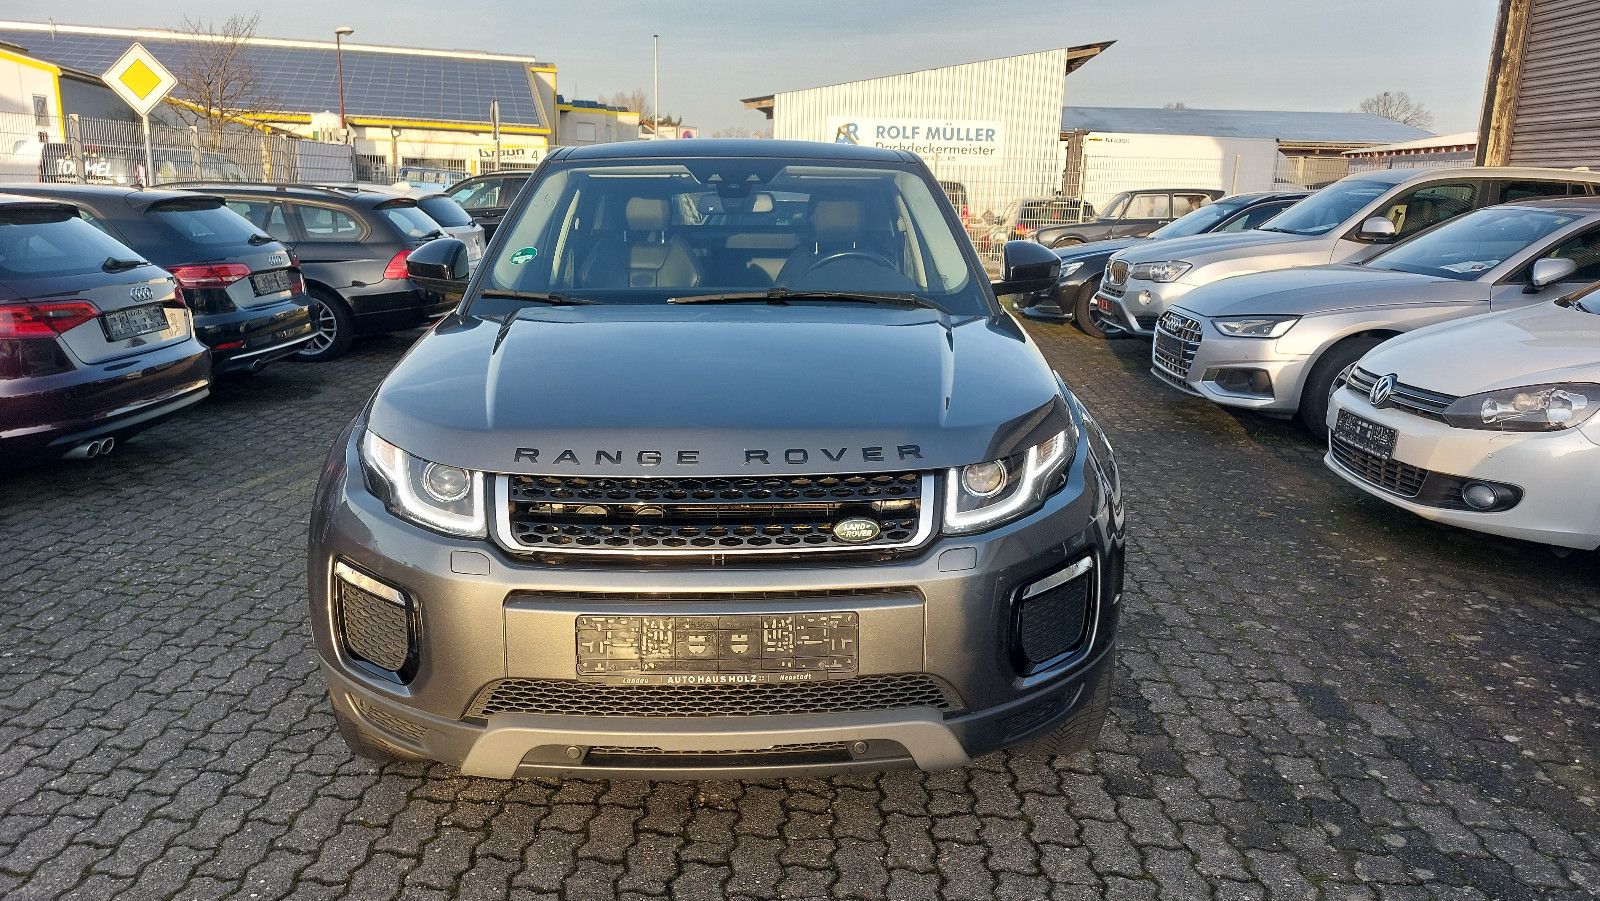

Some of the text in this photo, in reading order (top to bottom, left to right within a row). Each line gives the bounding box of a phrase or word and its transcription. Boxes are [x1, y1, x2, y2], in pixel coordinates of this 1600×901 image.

[876, 123, 996, 142] ROLF MÜLLER
[531, 150, 539, 161] 4
[513, 444, 924, 467] RANGE ROVER
[844, 523, 866, 531] LAND
[845, 529, 873, 538] ROVER
